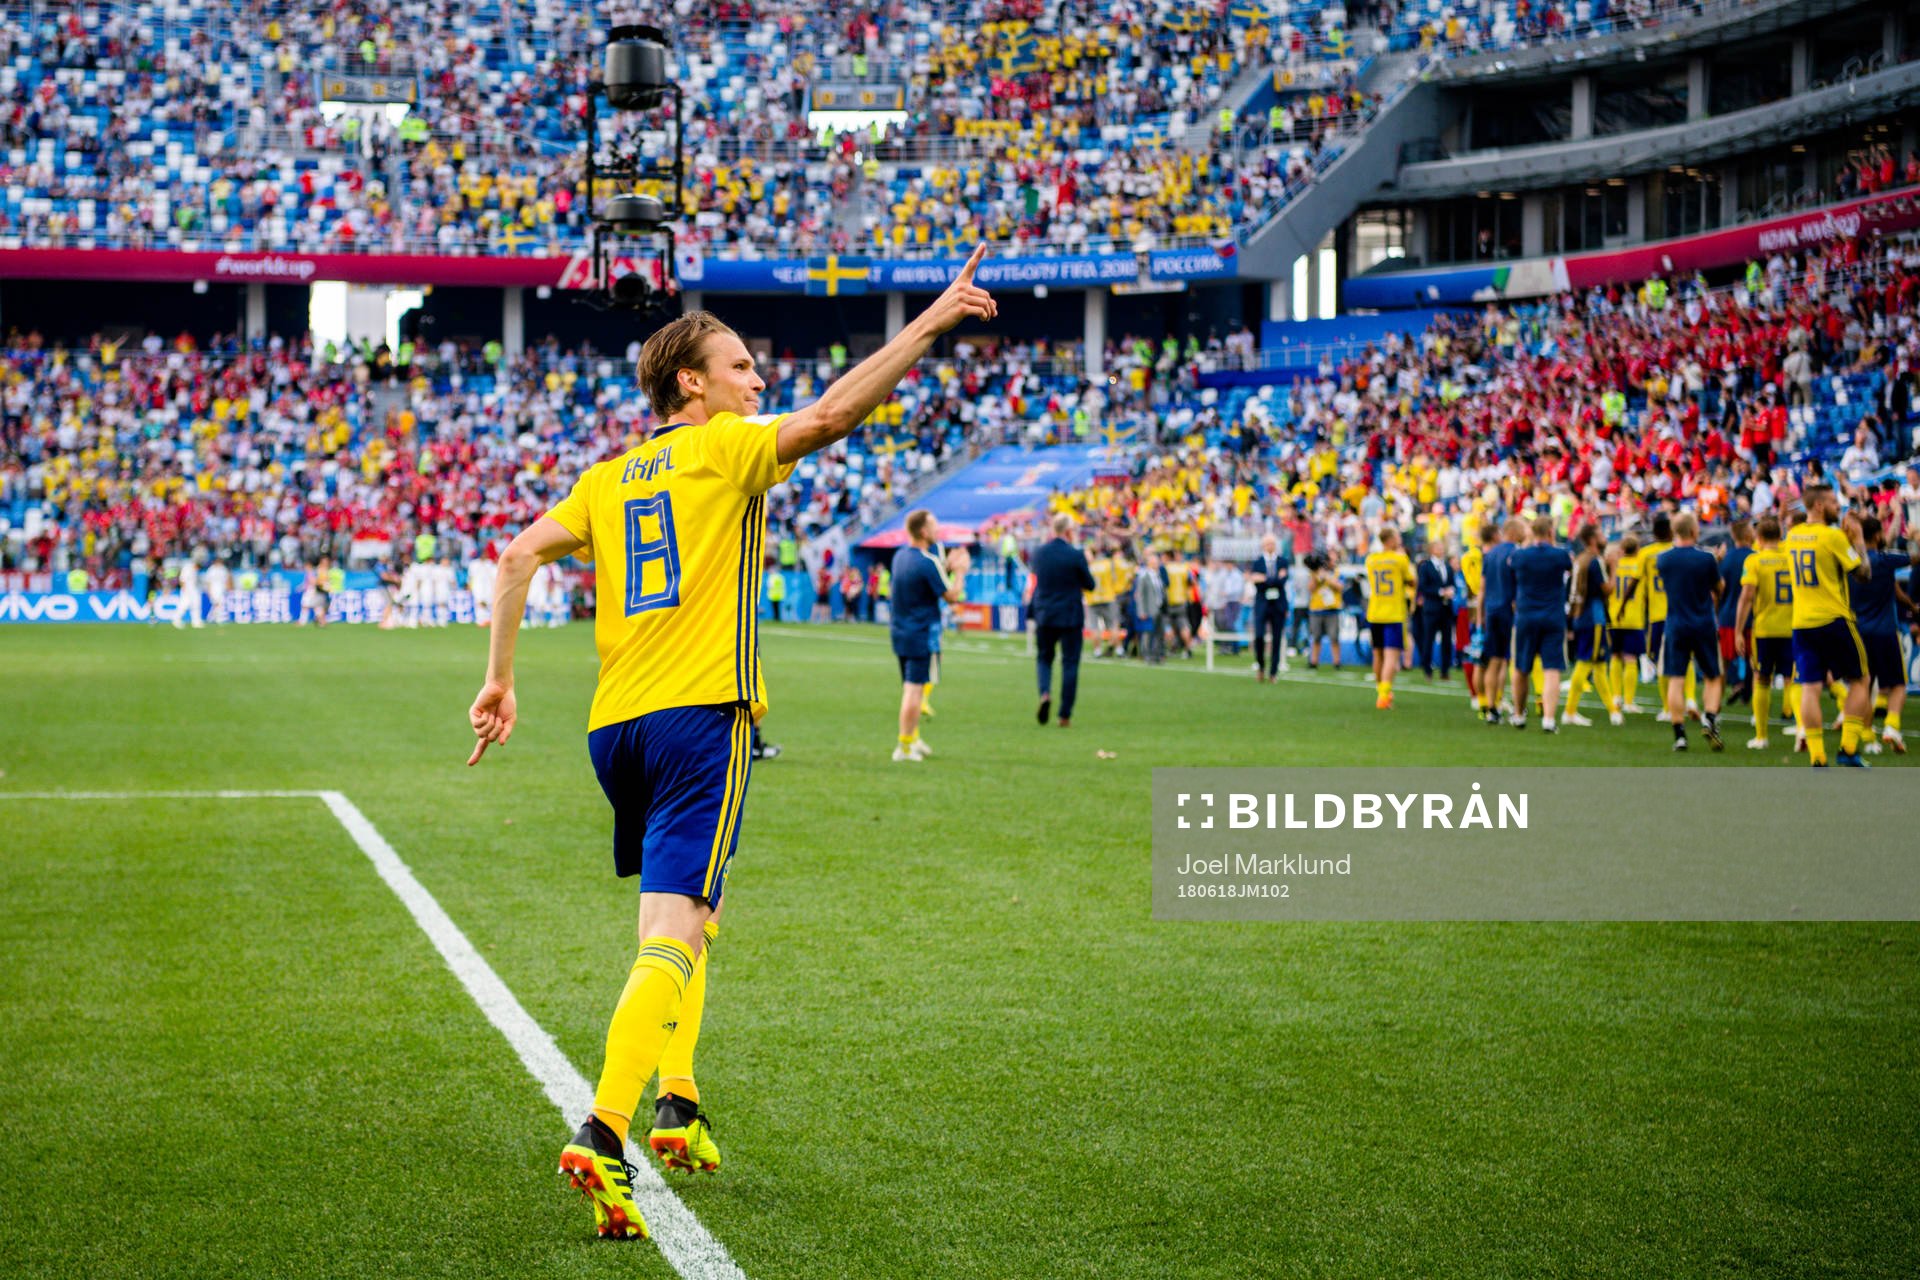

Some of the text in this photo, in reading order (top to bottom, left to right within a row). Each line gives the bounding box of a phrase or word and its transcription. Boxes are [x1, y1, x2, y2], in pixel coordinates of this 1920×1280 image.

[216, 256, 315, 278] #worldcup
[624, 490, 681, 617] 8
[1790, 549, 1819, 587] 18
[1373, 569, 1393, 596] 15
